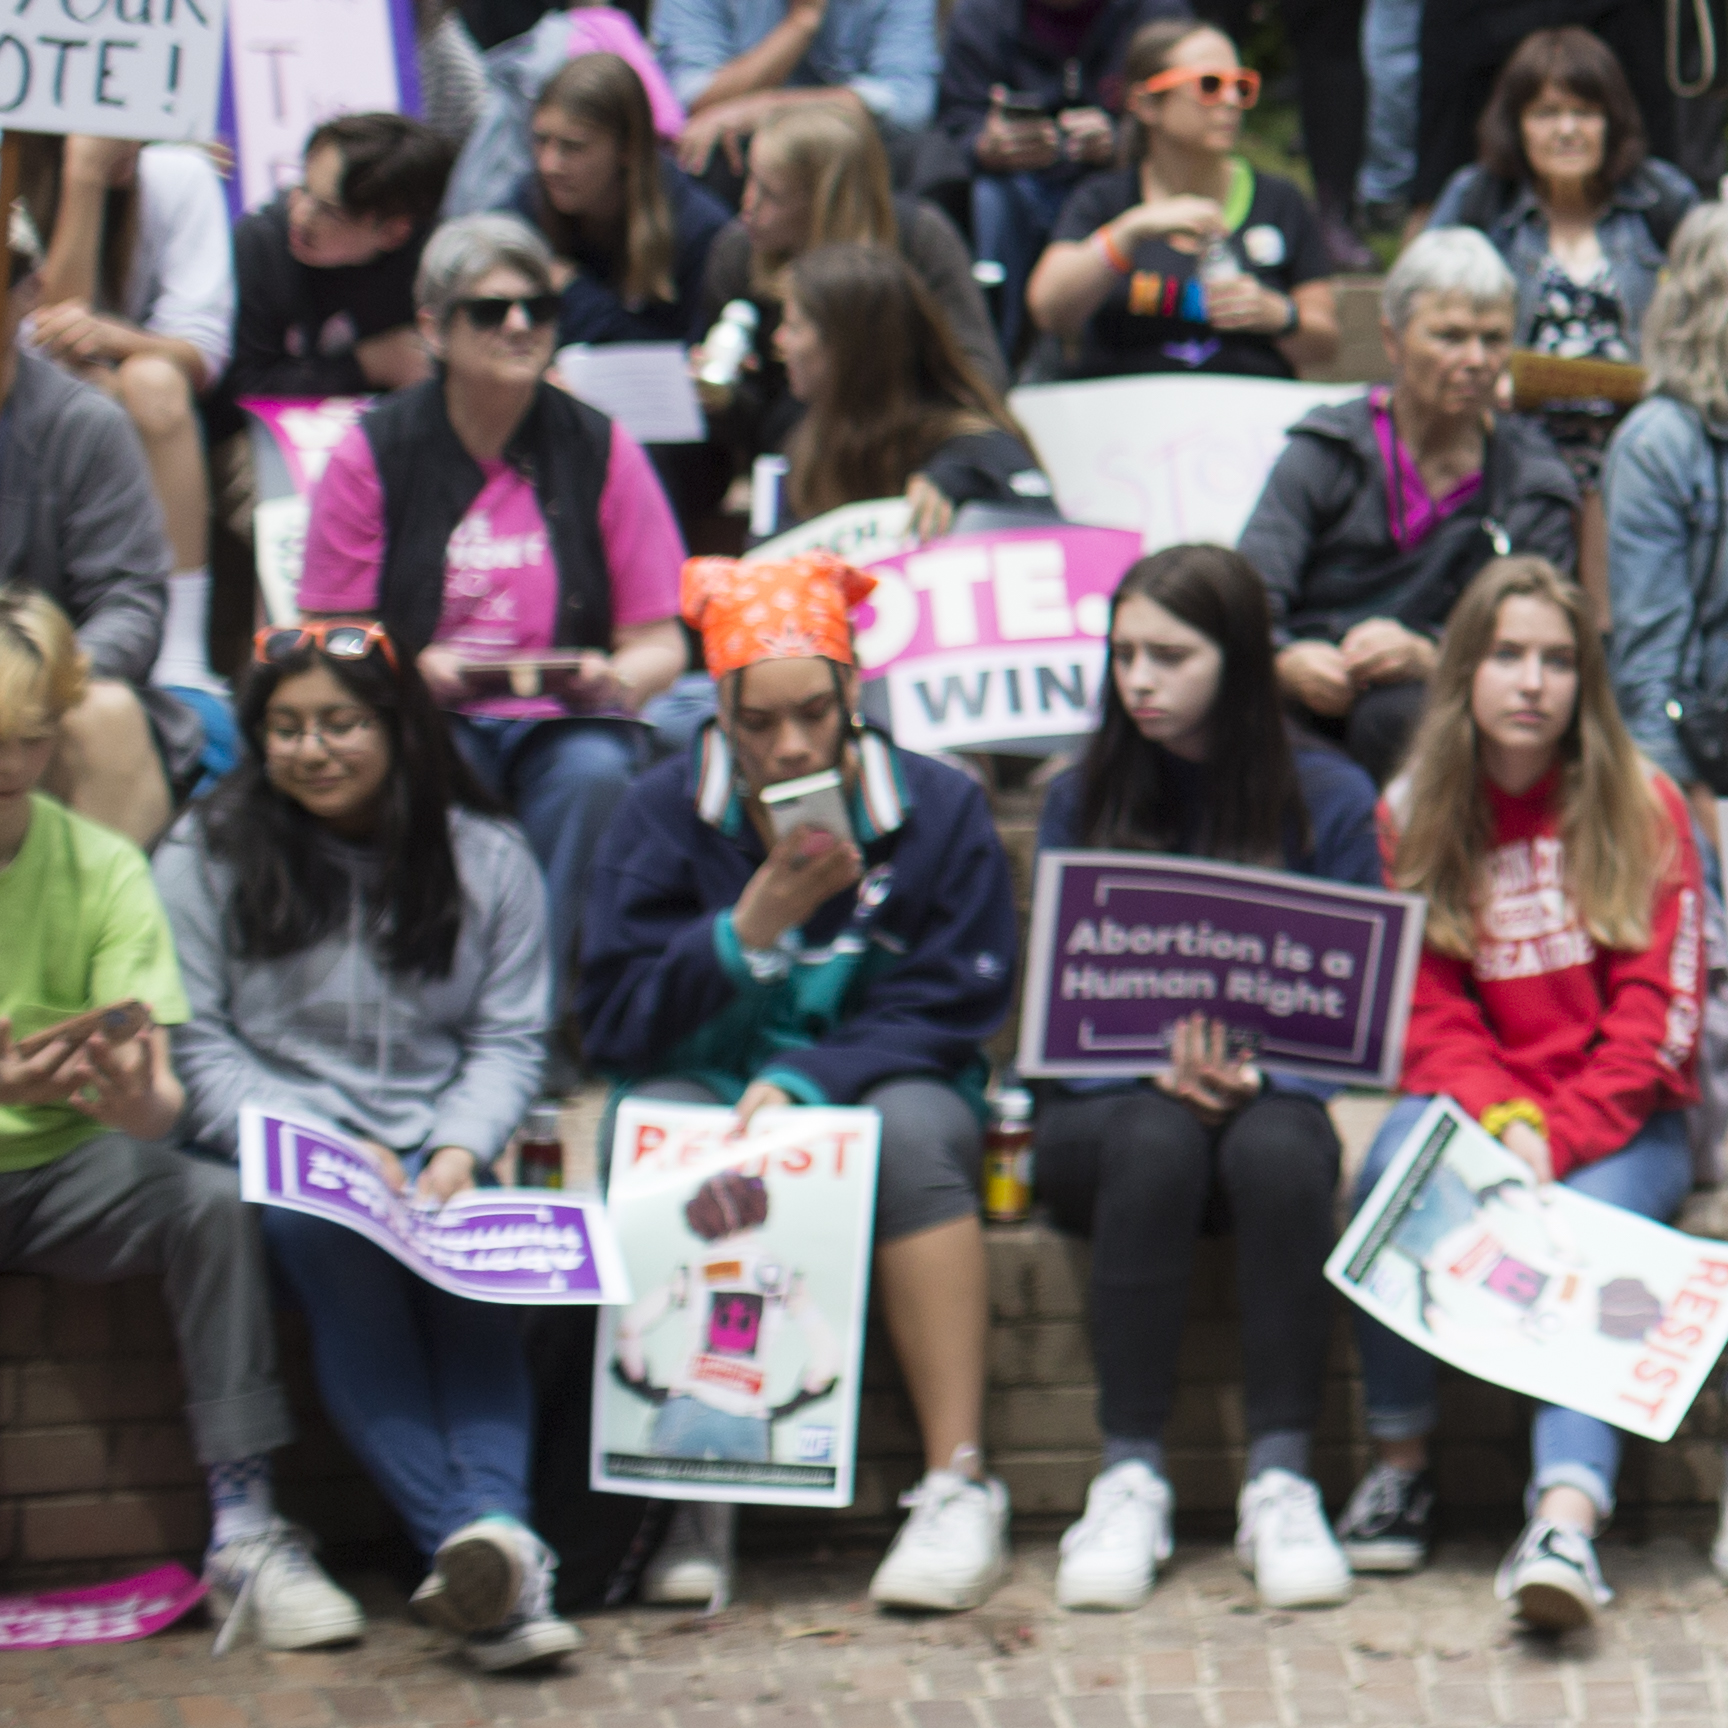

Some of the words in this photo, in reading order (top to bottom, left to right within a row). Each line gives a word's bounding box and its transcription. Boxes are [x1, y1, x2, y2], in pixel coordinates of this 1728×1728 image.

[0, 34, 181, 115] OTE!
[853, 540, 1109, 670] OTE.
[1066, 918, 1265, 964] Abortion
[1272, 931, 1312, 972] is
[1321, 950, 1354, 979] a
[1060, 963, 1216, 1000] Human
[1224, 969, 1345, 1019] Right
